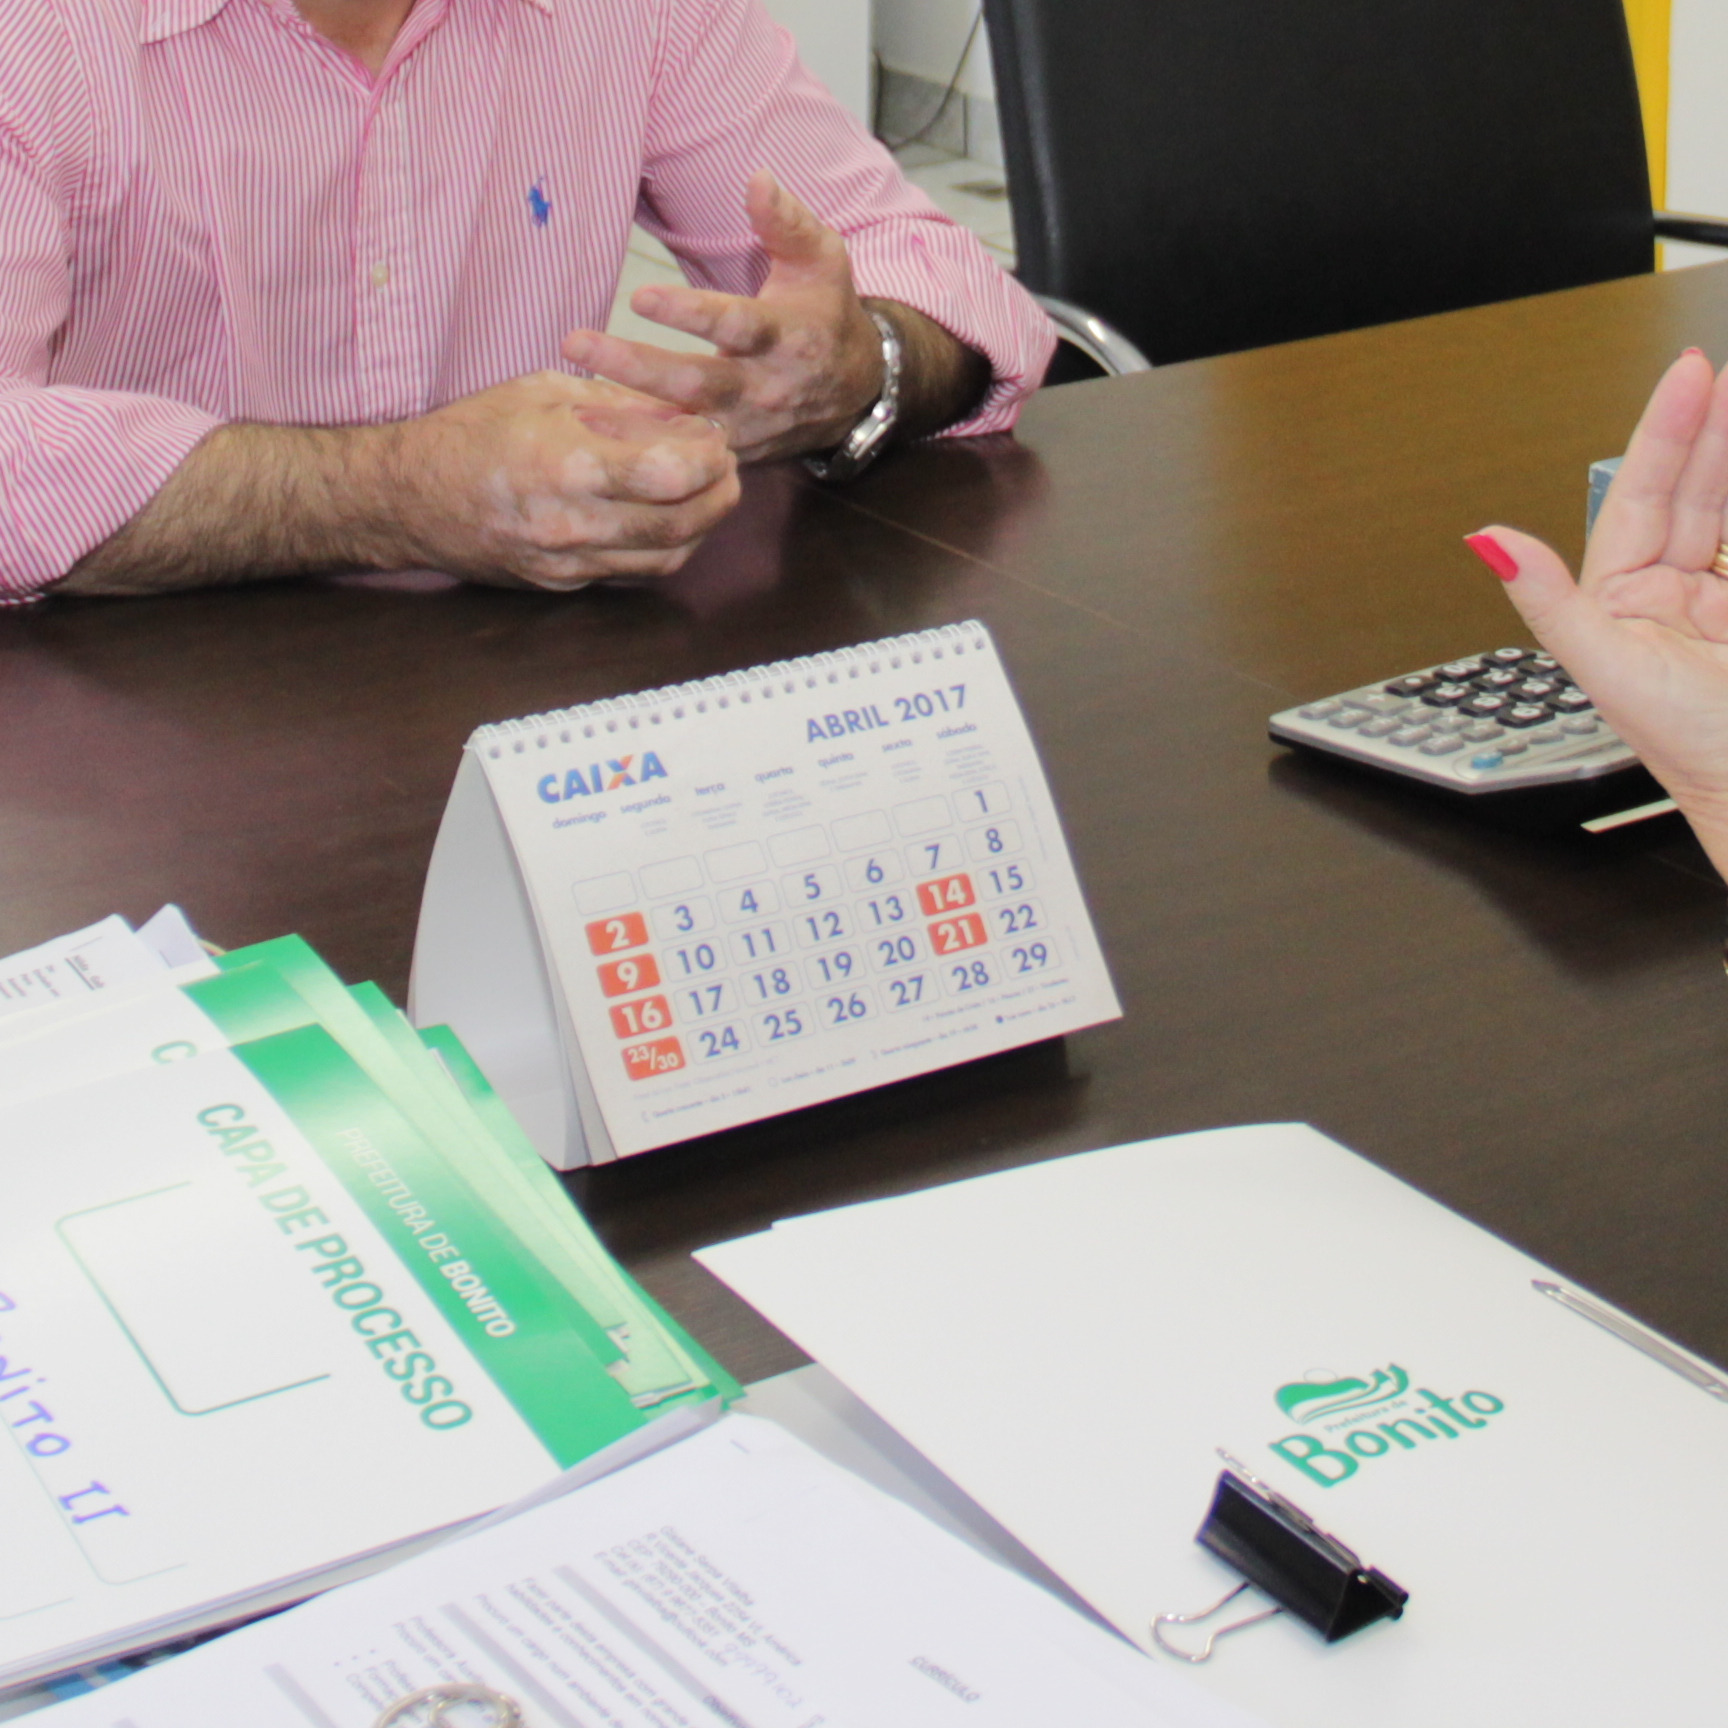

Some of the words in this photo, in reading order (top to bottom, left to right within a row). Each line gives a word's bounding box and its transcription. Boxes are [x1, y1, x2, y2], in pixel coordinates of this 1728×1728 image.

[807, 705, 889, 743] ABRIL
[894, 684, 966, 722] 2017
[537, 751, 668, 804] CAIXA
[552, 810, 607, 829] domingo
[620, 794, 671, 814] segunda
[882, 738, 912, 753] sexta
[974, 789, 989, 813] 1
[605, 920, 631, 950] 2
[674, 905, 694, 931] 3
[740, 889, 759, 913] 4
[803, 873, 821, 900] 5
[865, 858, 884, 884] 6
[925, 843, 940, 869] 7
[985, 828, 1003, 853] 8
[616, 960, 640, 990] 9
[677, 943, 715, 974] 10
[741, 928, 776, 958] 11
[805, 911, 844, 941] 12
[868, 895, 904, 925] 13
[928, 878, 966, 910] 14
[989, 865, 1023, 894] 15
[621, 1001, 664, 1034] 16
[689, 984, 723, 1016] 17
[753, 968, 791, 999] 18
[817, 951, 853, 982] 19
[878, 936, 915, 967] 20
[937, 919, 975, 952] 21
[999, 904, 1038, 934] 22
[699, 1025, 740, 1058] 24
[763, 1009, 803, 1040] 25
[827, 992, 867, 1024] 26
[890, 975, 924, 1007] 27
[952, 960, 990, 992] 28
[1012, 943, 1047, 973] 29
[337, 1126, 436, 1236] PREFEITURA
[196, 1103, 289, 1189] CAPA
[258, 1185, 331, 1236] DE
[295, 1233, 474, 1432] PROCESSO
[419, 1232, 460, 1267] DE
[438, 1259, 517, 1339] BONITO
[1268, 1388, 1505, 1489] Bonito
[1324, 1409, 1389, 1433] Prefeitura
[1390, 1399, 1409, 1413] de
